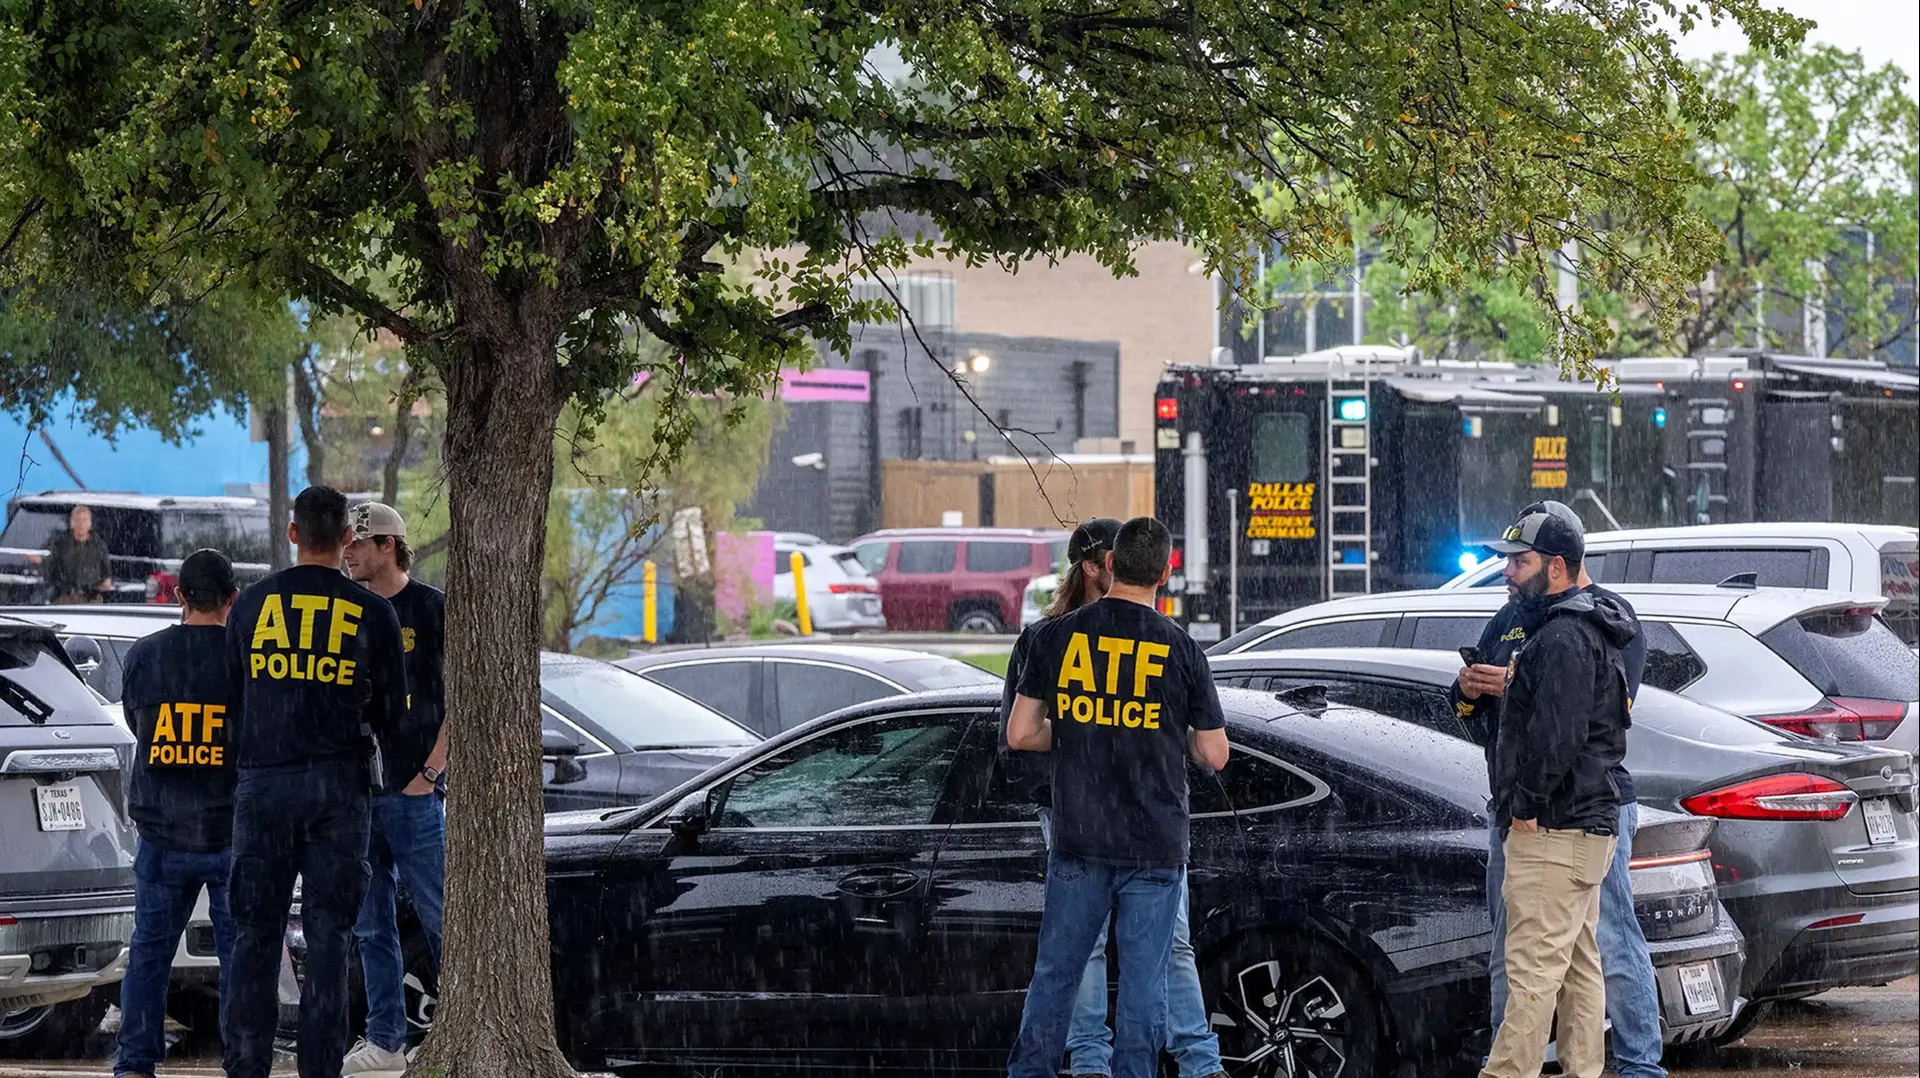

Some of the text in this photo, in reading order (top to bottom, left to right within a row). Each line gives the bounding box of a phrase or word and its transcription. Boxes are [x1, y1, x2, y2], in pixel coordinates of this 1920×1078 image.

[1533, 436, 1567, 460] POLICE
[1248, 483, 1315, 497] DALLAS
[1250, 496, 1312, 510] POLICE
[1247, 526, 1315, 538] COMMAND
[1249, 516, 1312, 527] INCIDENT
[251, 593, 362, 654] ATF
[250, 653, 356, 685] POLICE
[1057, 631, 1169, 698] ATF
[1057, 692, 1161, 729] POLICE
[152, 702, 226, 743] ATF
[149, 745, 224, 765] POLICE
[50, 789, 68, 798] TEXAS
